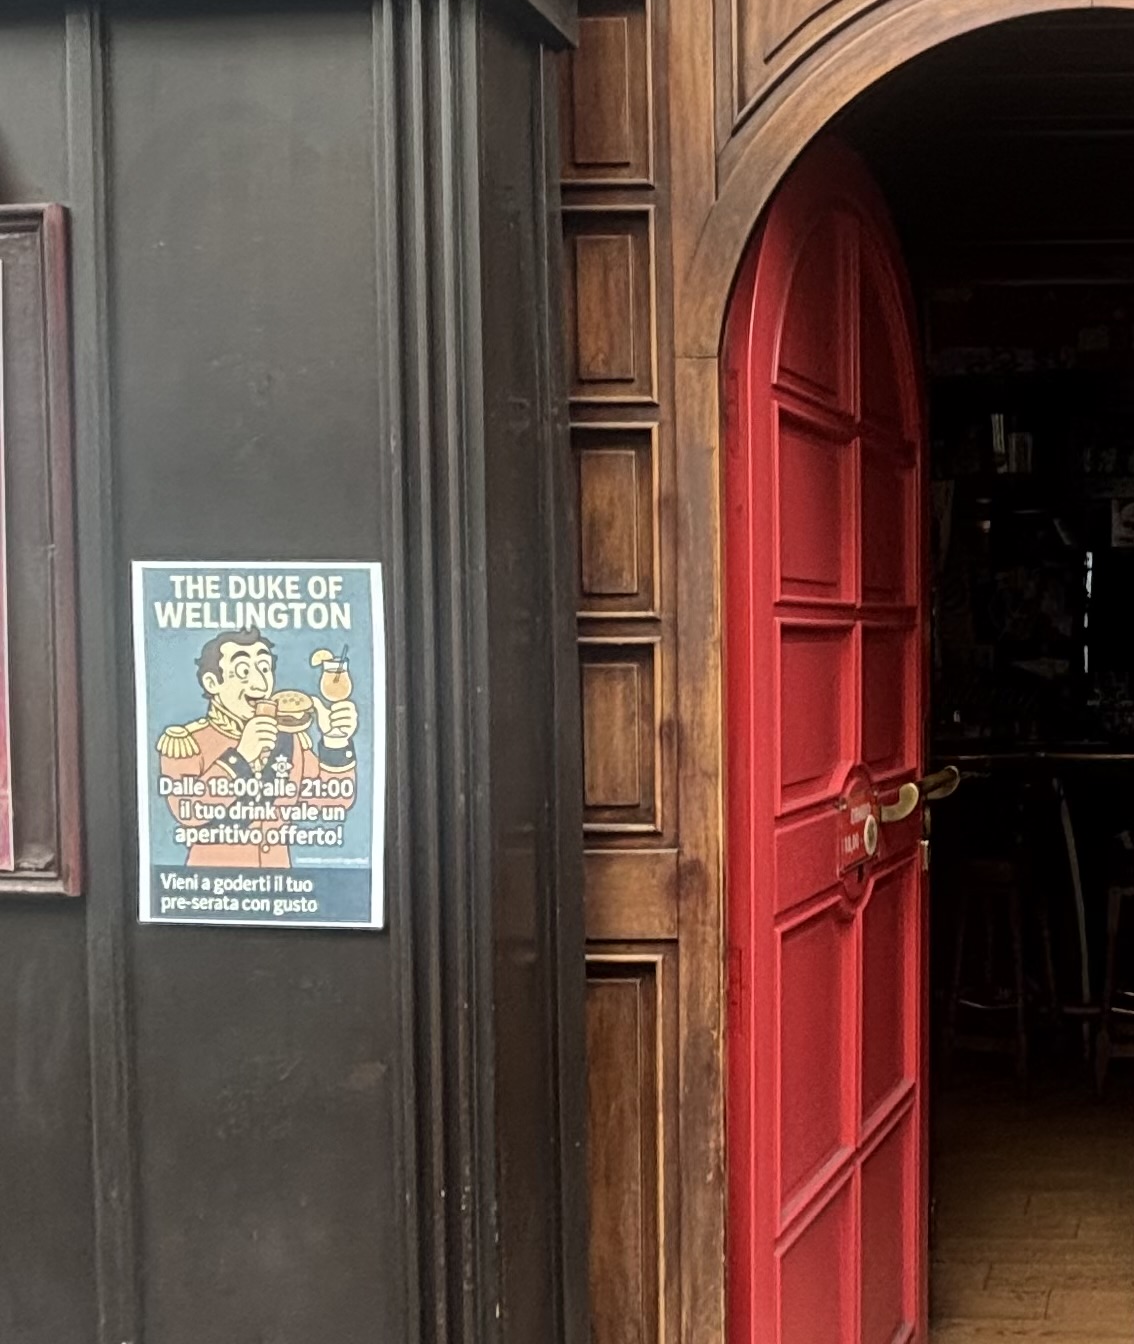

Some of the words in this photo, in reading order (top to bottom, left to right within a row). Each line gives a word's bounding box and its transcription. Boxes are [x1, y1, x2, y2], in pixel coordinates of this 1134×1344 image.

[169, 575, 221, 600] THE
[228, 575, 301, 600] DUKE
[307, 575, 343, 600] OF
[154, 601, 351, 630] WELLINGTON
[159, 777, 205, 796] Dalle
[262, 778, 296, 797] alle
[301, 779, 354, 797] 21:00
[180, 799, 191, 819] il
[195, 804, 225, 820] tuo
[229, 800, 277, 820] drink
[281, 805, 318, 821] vale
[323, 808, 345, 820] un
[175, 825, 263, 847] aperitivo
[266, 825, 343, 846] offerto!
[160, 873, 199, 890] Vieni
[201, 879, 210, 891] a
[213, 875, 271, 894] goderti
[274, 875, 283, 892] il
[287, 877, 313, 892] tuo
[161, 895, 239, 913] pre-serata
[242, 898, 270, 912] con
[273, 897, 318, 916] gusto
